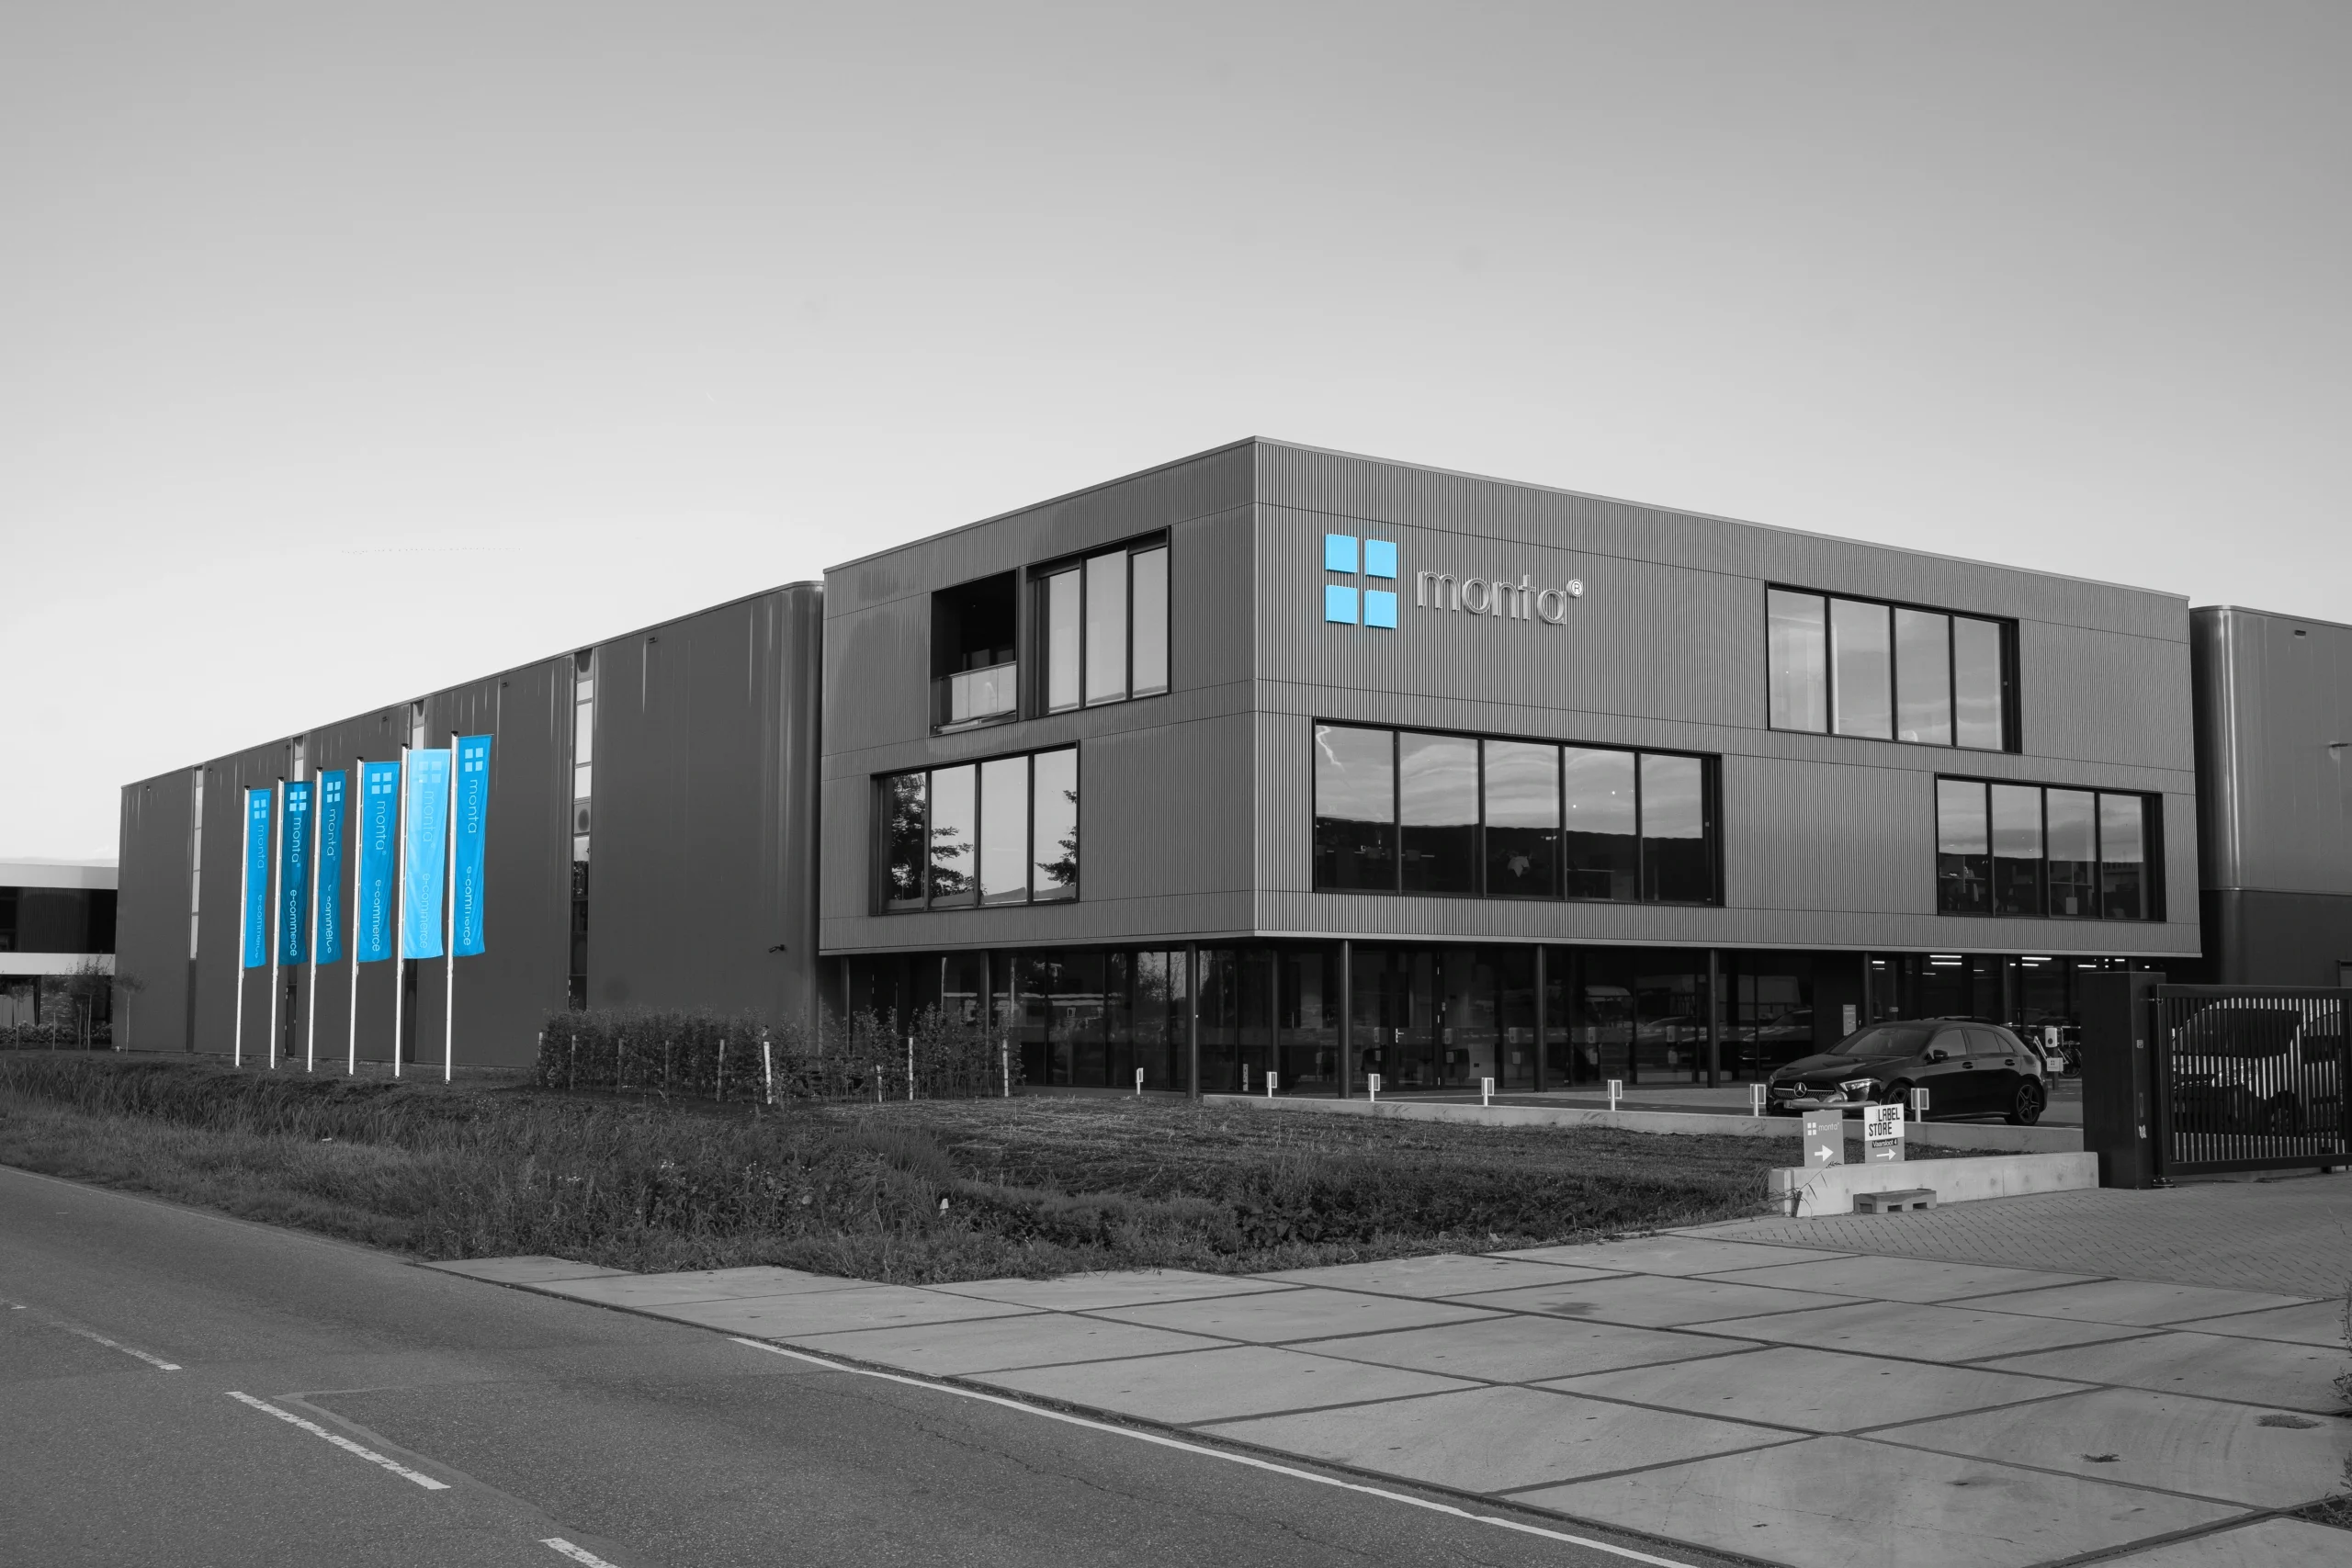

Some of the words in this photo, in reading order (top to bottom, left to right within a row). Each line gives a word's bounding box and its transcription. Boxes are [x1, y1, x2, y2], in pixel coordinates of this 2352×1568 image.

[468, 779, 480, 834] monta
[289, 889, 298, 956] e-commerce
[372, 879, 381, 952] e-commerce
[420, 873, 430, 949] e-commerce
[1869, 1122, 1893, 1136] STORE
[1878, 1107, 1900, 1122] LABEL
